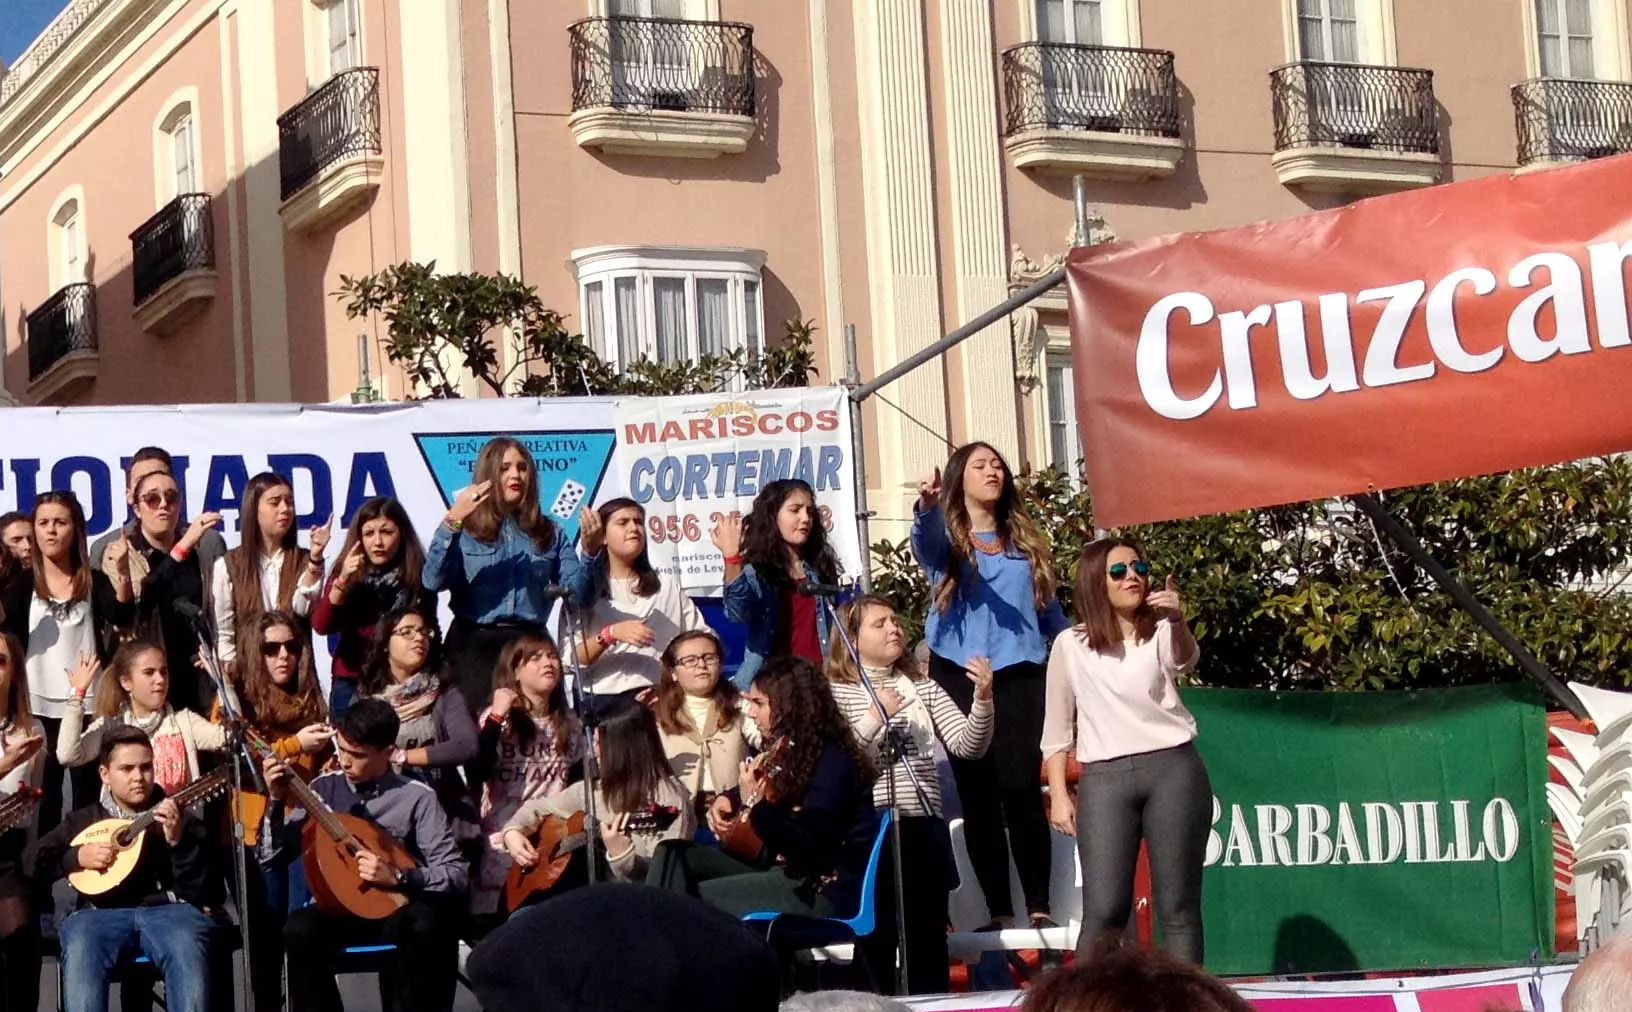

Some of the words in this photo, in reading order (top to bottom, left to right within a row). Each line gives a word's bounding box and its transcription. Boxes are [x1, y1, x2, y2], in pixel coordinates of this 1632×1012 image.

[625, 410, 840, 445] MARISCOS
[630, 445, 844, 504] CORTEMAR
[648, 514, 701, 544] 956
